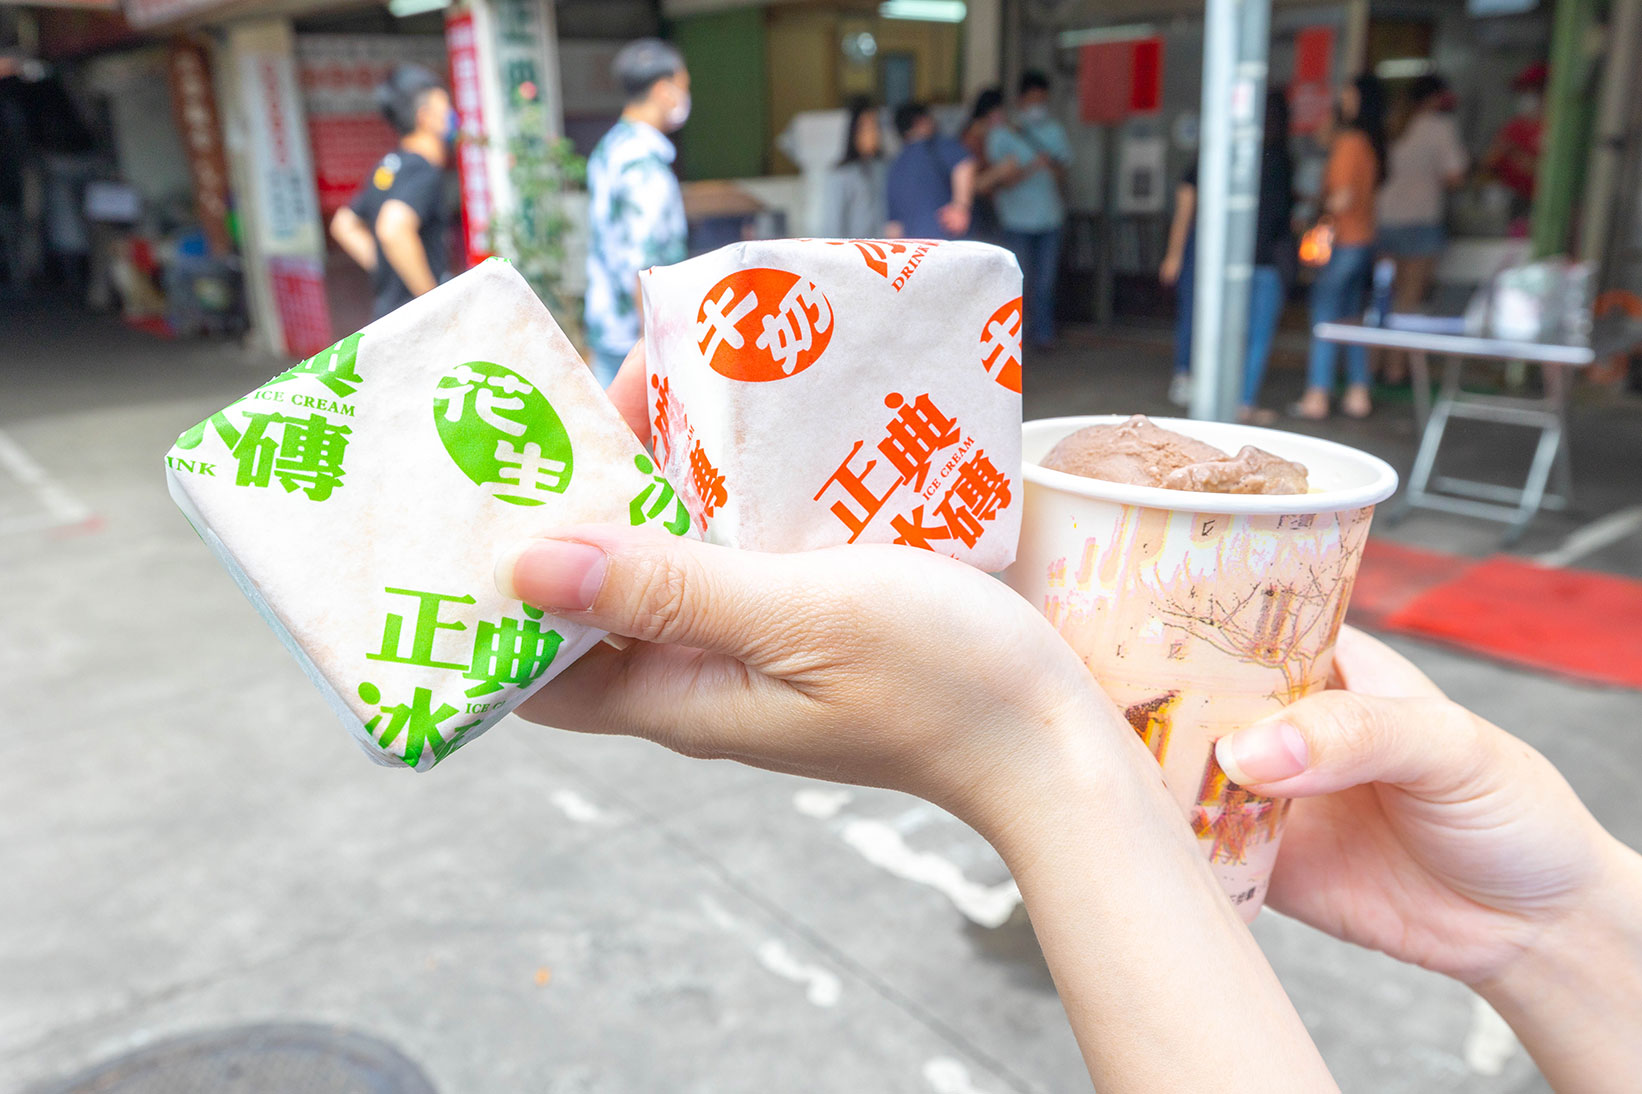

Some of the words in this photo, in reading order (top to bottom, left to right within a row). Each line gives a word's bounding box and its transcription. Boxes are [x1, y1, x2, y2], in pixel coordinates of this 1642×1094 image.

[890, 245, 931, 293] DRINK
[697, 276, 833, 376] 牛奶
[254, 391, 284, 403] ICE
[290, 393, 356, 417] CREAM
[435, 364, 567, 502] 花生
[165, 456, 217, 477] INK
[813, 392, 961, 545] 正典
[922, 478, 941, 501] ICE
[940, 436, 975, 478] CREAM
[366, 587, 565, 698] 正典
[465, 703, 489, 714] ICE
